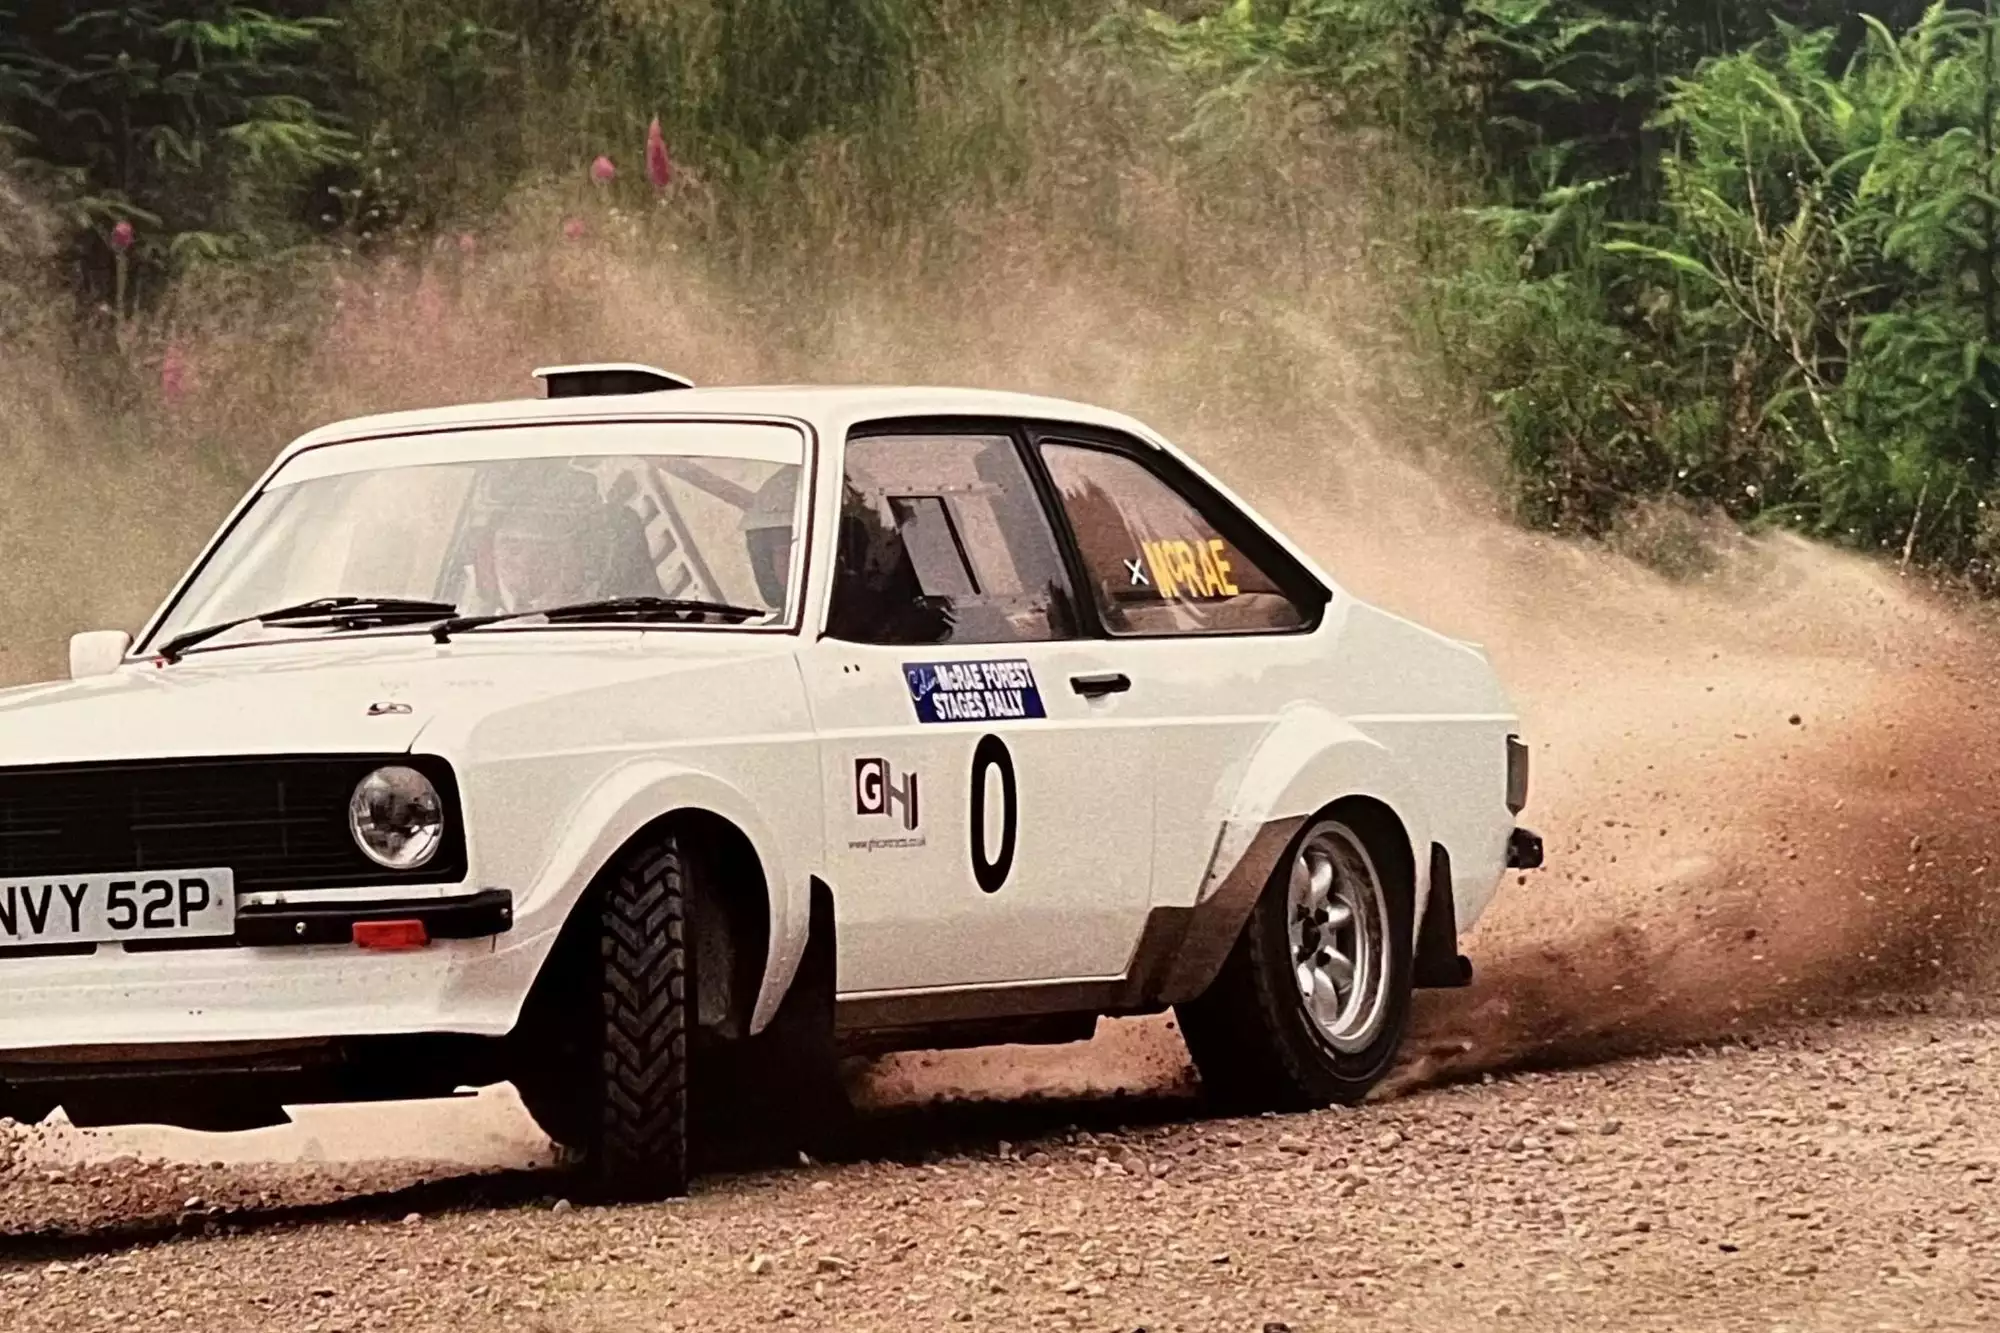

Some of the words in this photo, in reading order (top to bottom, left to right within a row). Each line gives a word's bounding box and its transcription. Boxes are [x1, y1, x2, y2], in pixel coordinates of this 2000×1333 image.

[981, 662, 1034, 689] FOREST
[932, 692, 986, 720] STAGES
[983, 690, 1025, 717] RALLY
[970, 734, 1017, 893] 0
[0, 883, 88, 935] NVY
[107, 878, 210, 930] 52P
